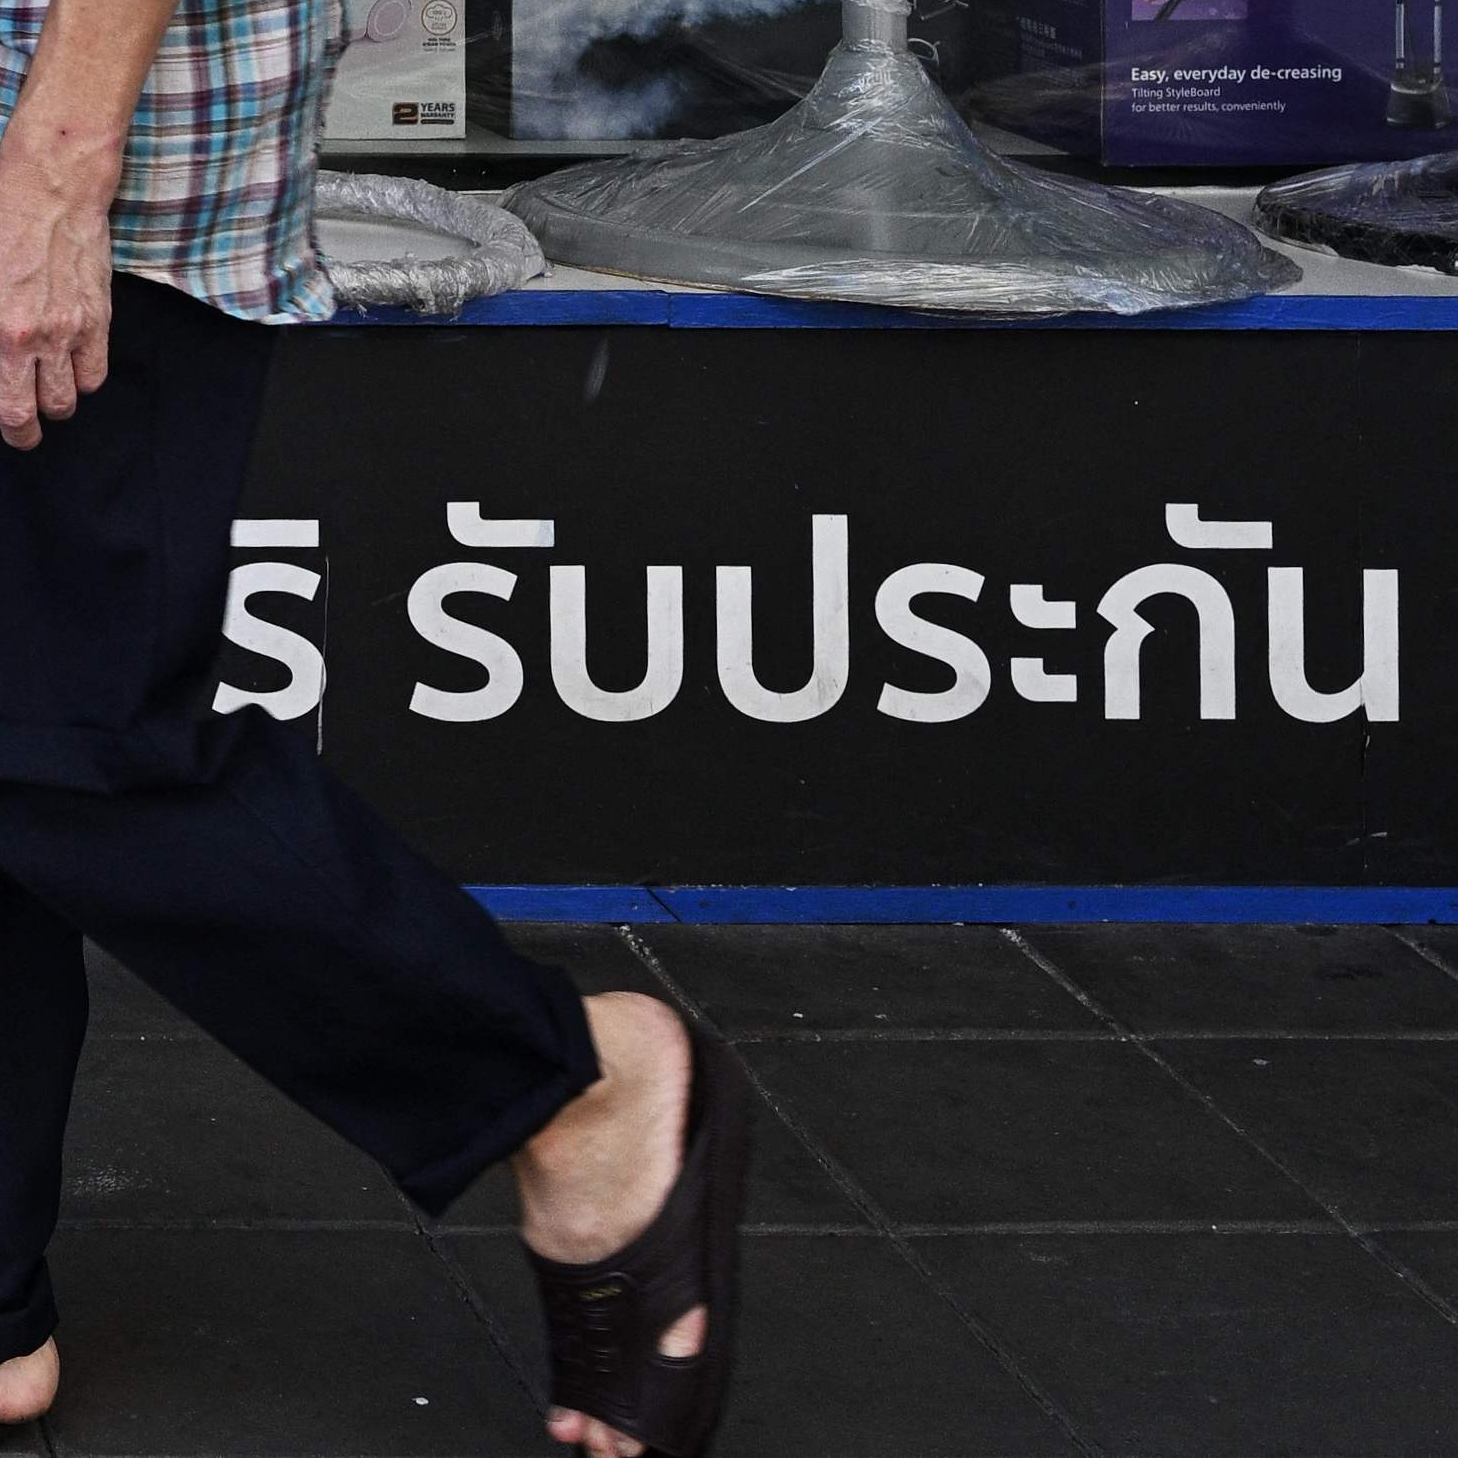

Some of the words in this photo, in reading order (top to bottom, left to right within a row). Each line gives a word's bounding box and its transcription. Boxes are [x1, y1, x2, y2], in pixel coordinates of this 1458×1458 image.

[1131, 67, 1169, 84] Easy,
[1174, 66, 1246, 84] everyday
[1250, 64, 1343, 82] de-creasing
[1131, 87, 1163, 100] Tilting
[1165, 86, 1221, 99] StyleBoard
[420, 102, 456, 112] YEARS
[1131, 102, 1146, 113] for
[1148, 101, 1181, 112] better
[1182, 101, 1219, 112] results,
[1221, 100, 1286, 112] conveniently
[406, 501, 1401, 723] รับประกัน
